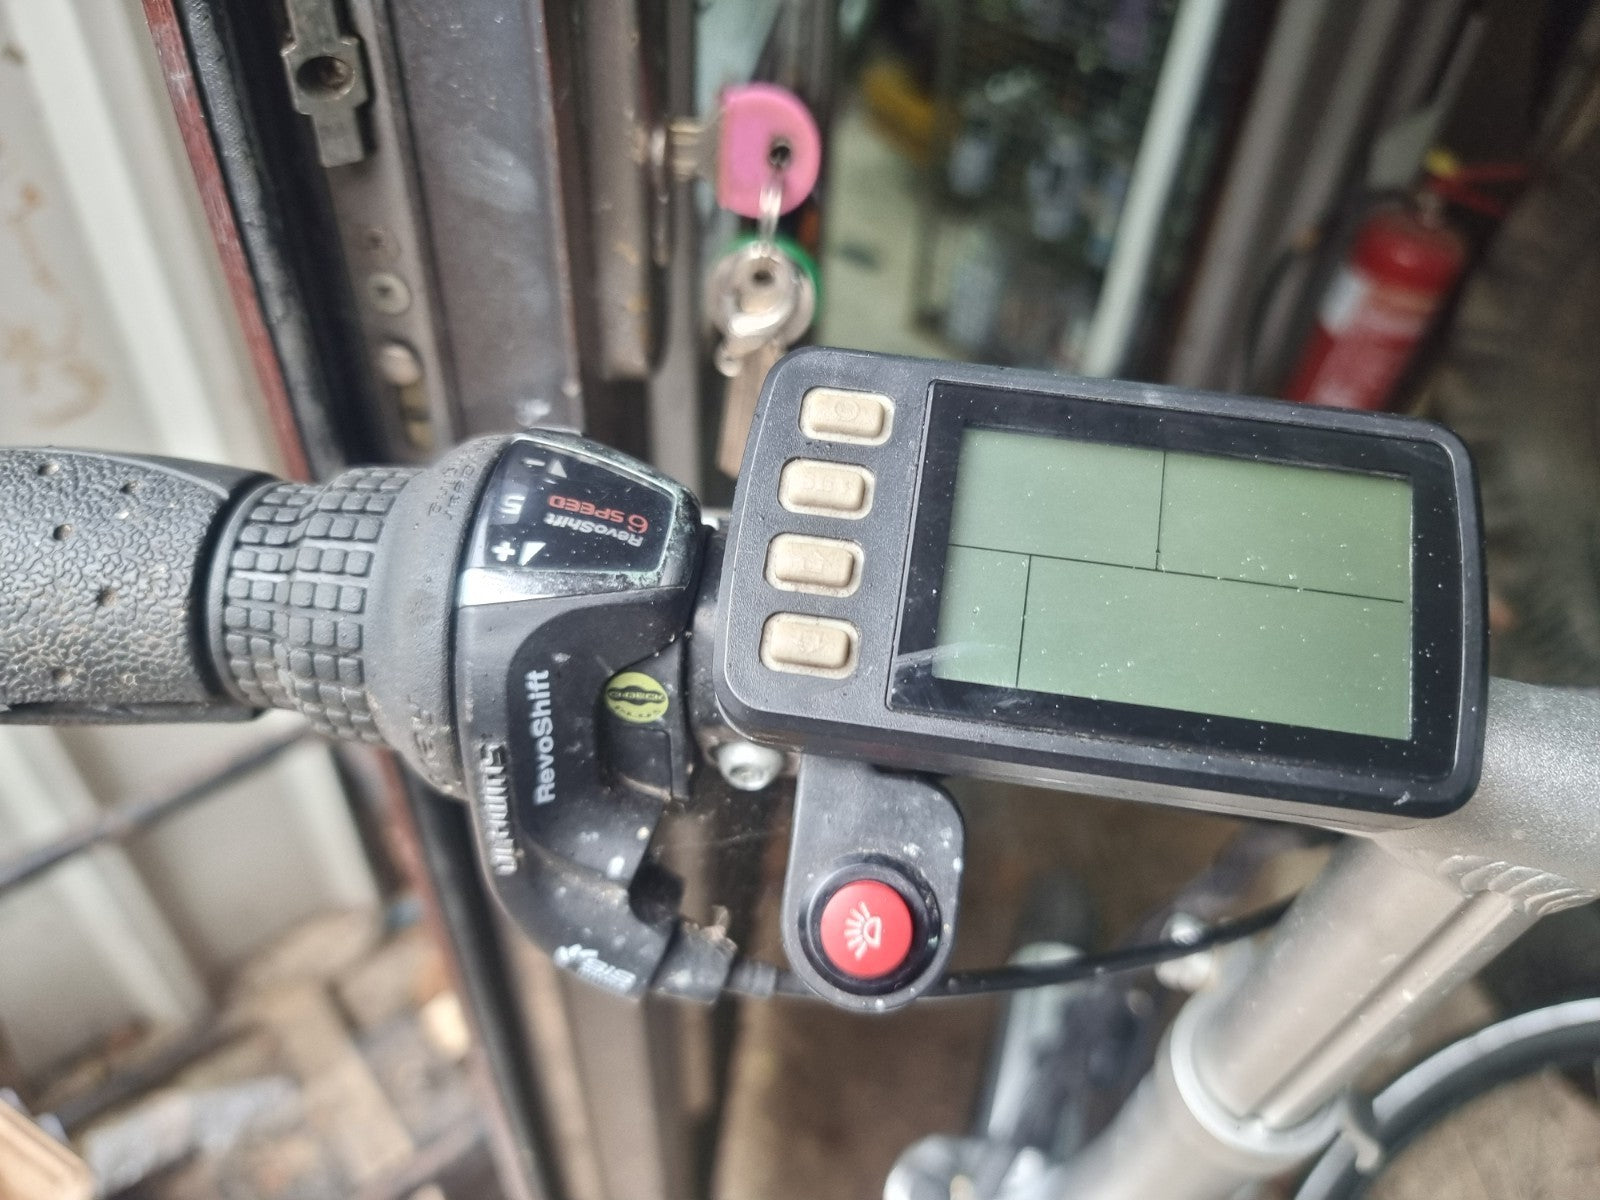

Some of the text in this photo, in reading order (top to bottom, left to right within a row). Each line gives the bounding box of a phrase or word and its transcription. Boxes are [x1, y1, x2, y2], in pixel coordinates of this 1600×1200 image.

[543, 512, 644, 548] RevoShift
[547, 494, 649, 535] 6 SPEED
[525, 670, 556, 805] RevoShift
